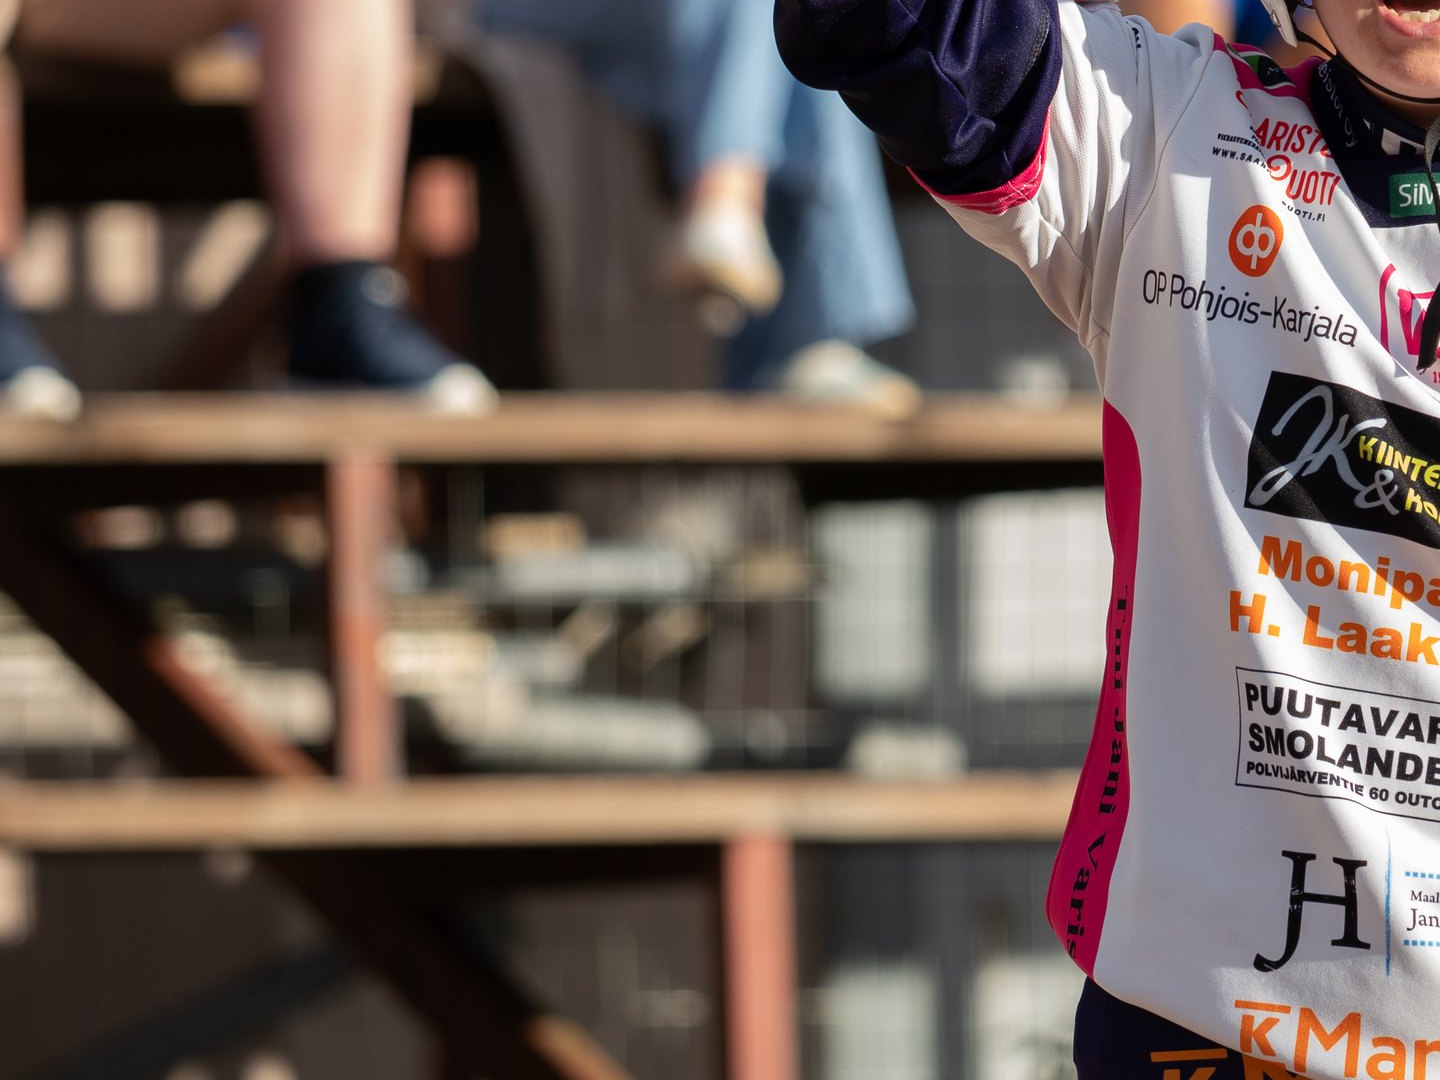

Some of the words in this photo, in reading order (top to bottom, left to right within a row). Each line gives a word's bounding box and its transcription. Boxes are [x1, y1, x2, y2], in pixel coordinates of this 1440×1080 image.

[1142, 269, 1167, 305] OP
[1169, 274, 1358, 347] Pohjois-Karjala
[1228, 590, 1281, 637] H.
[1098, 706, 1125, 815] Jani
[1246, 761, 1365, 796] POLVIJÄRVENTIE
[1369, 786, 1390, 802] 60
